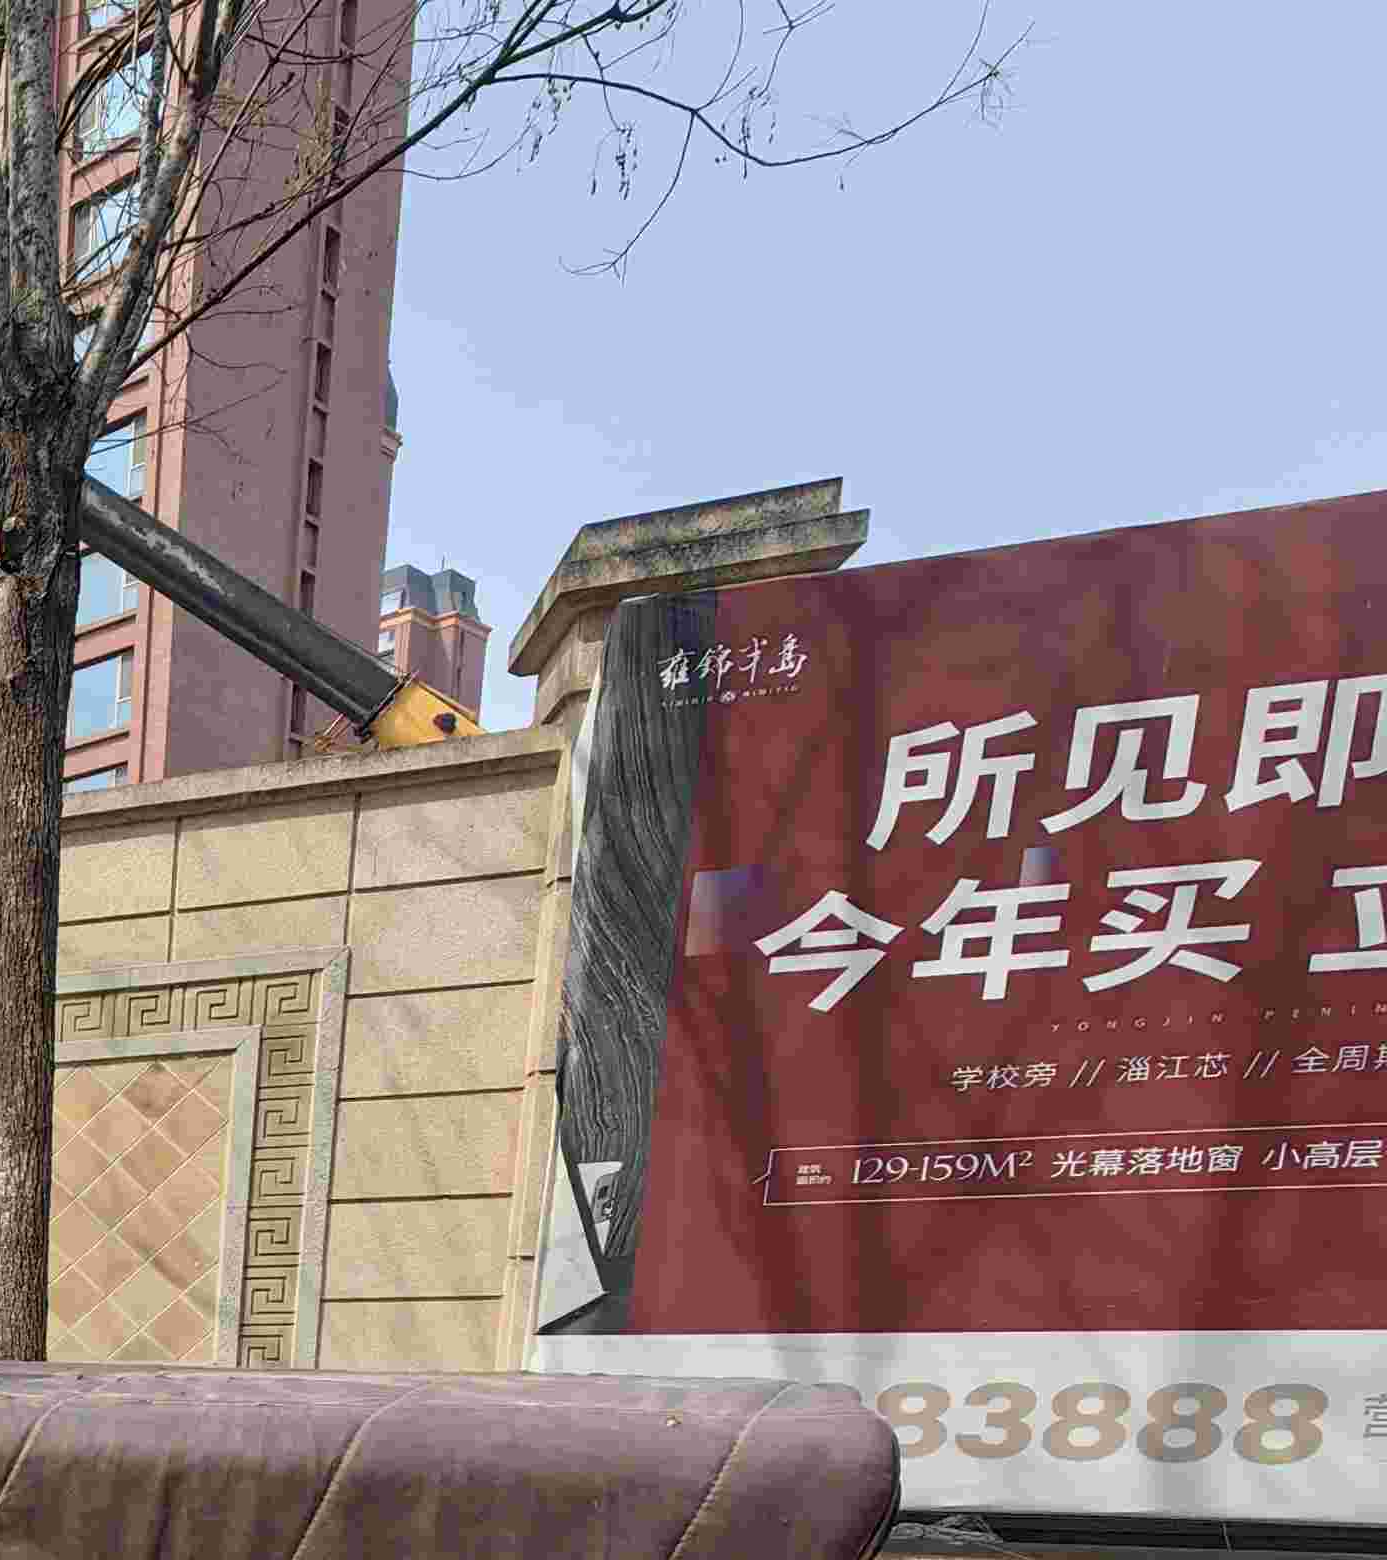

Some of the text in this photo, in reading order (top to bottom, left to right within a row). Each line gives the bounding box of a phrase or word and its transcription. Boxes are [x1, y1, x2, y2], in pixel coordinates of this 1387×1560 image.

[865, 672, 1387, 851] 所见即
[951, 1062, 1058, 1092] 学校旁
[1115, 1052, 1231, 1083] 淄江芯
[1050, 1143, 1244, 1178] 光幕落地窗
[1261, 1138, 1384, 1170] 小高层
[813, 1381, 1329, 1465] 83888
